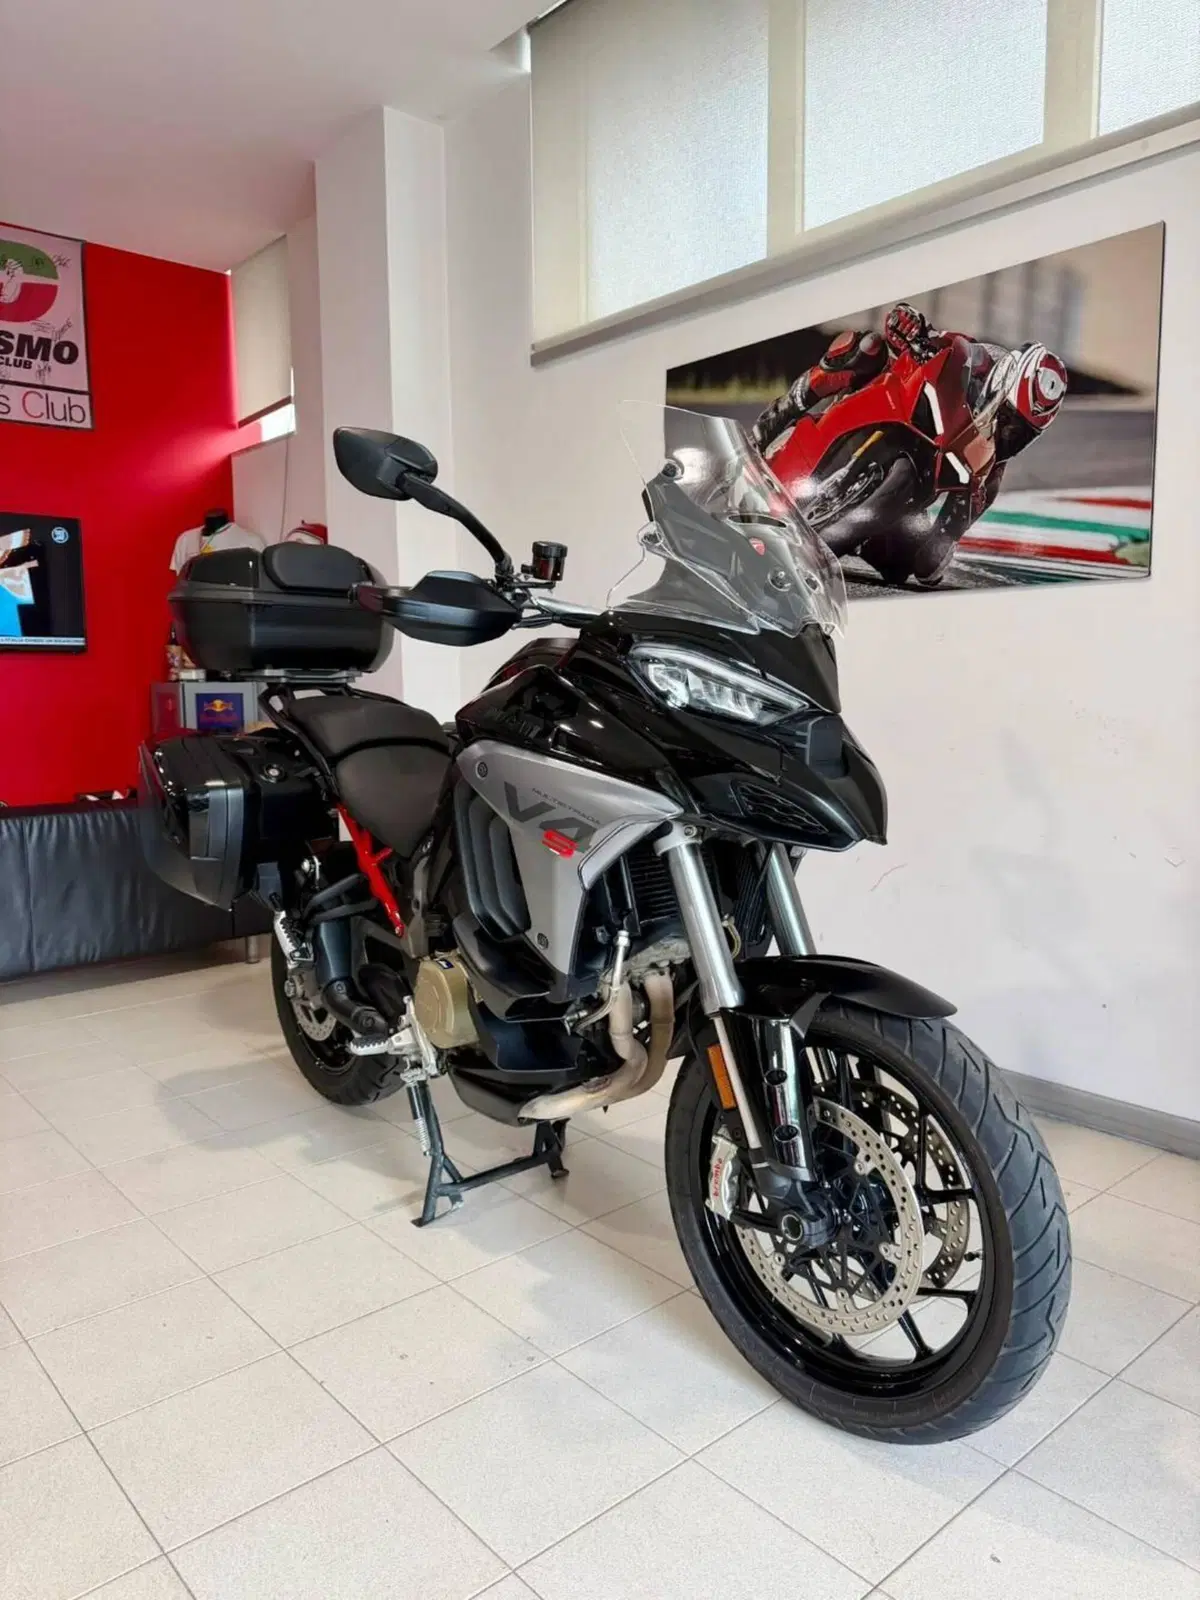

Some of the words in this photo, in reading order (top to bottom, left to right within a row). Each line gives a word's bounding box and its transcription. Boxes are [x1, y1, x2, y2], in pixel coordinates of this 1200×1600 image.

[0, 330, 79, 365] SMO
[21, 391, 86, 424] Club
[504, 781, 598, 854] V4
